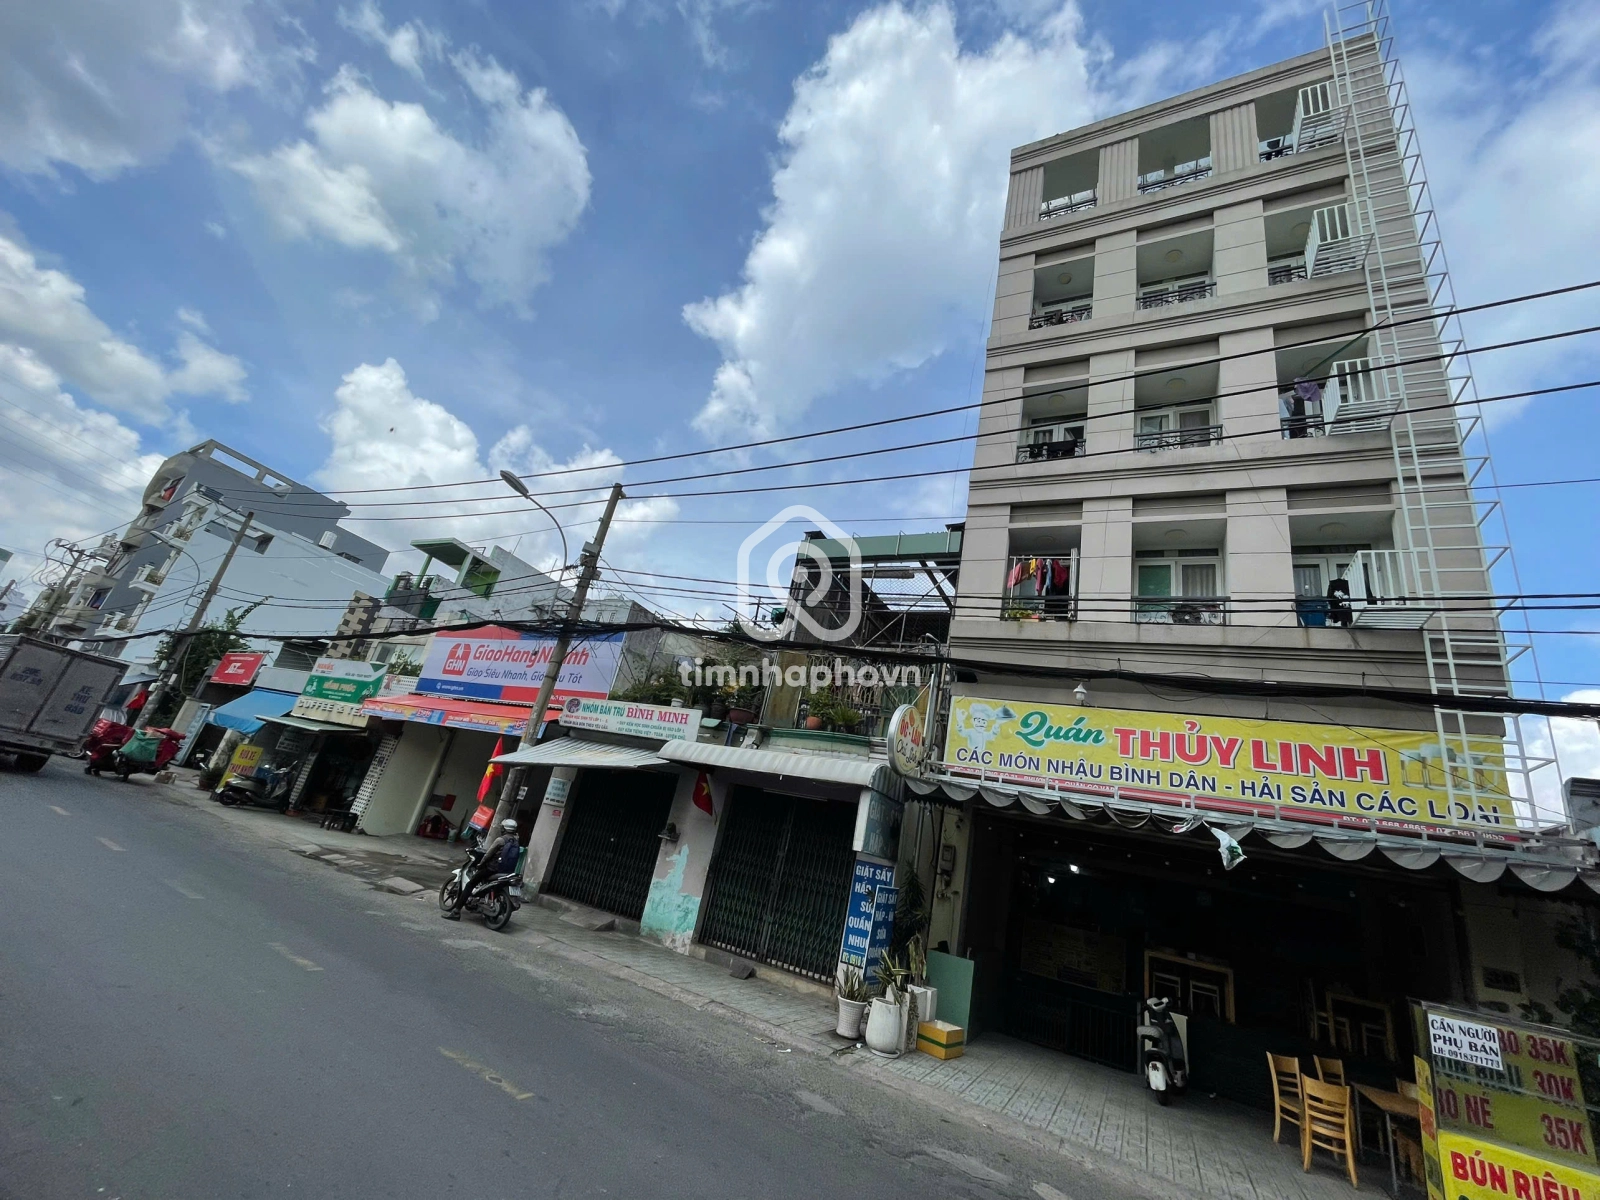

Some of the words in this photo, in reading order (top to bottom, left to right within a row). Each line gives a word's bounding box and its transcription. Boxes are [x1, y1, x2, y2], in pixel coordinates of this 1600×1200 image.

[445, 659, 466, 671] GHN
[467, 667, 483, 677] Giao
[568, 673, 583, 684] Tốt
[581, 702, 600, 713] NHÓM
[626, 705, 655, 720] BÌNH
[656, 711, 690, 725] MINH
[1015, 711, 1105, 747] Quán
[1113, 721, 1242, 768] THỦY
[1251, 739, 1387, 783] LINH
[956, 746, 993, 765] CÁC
[999, 750, 1040, 772] MÓN
[1047, 758, 1102, 779] NHẬU
[1110, 760, 1161, 787] BÌNH
[1169, 769, 1217, 793] DÂN
[1240, 777, 1281, 800] HẢI
[1291, 782, 1345, 808] SẢN
[1356, 791, 1417, 817] CÁC
[1430, 1018, 1455, 1034] CẦN
[1458, 1025, 1497, 1043] NGƯỜI
[1433, 1033, 1463, 1050] PHỤ
[1468, 1041, 1499, 1058] BÁN
[1433, 1046, 1446, 1055] LH:
[1447, 1049, 1500, 1068] 0918371773
[1540, 1113, 1588, 1155] 35K
[1450, 1150, 1508, 1194] BÚN
